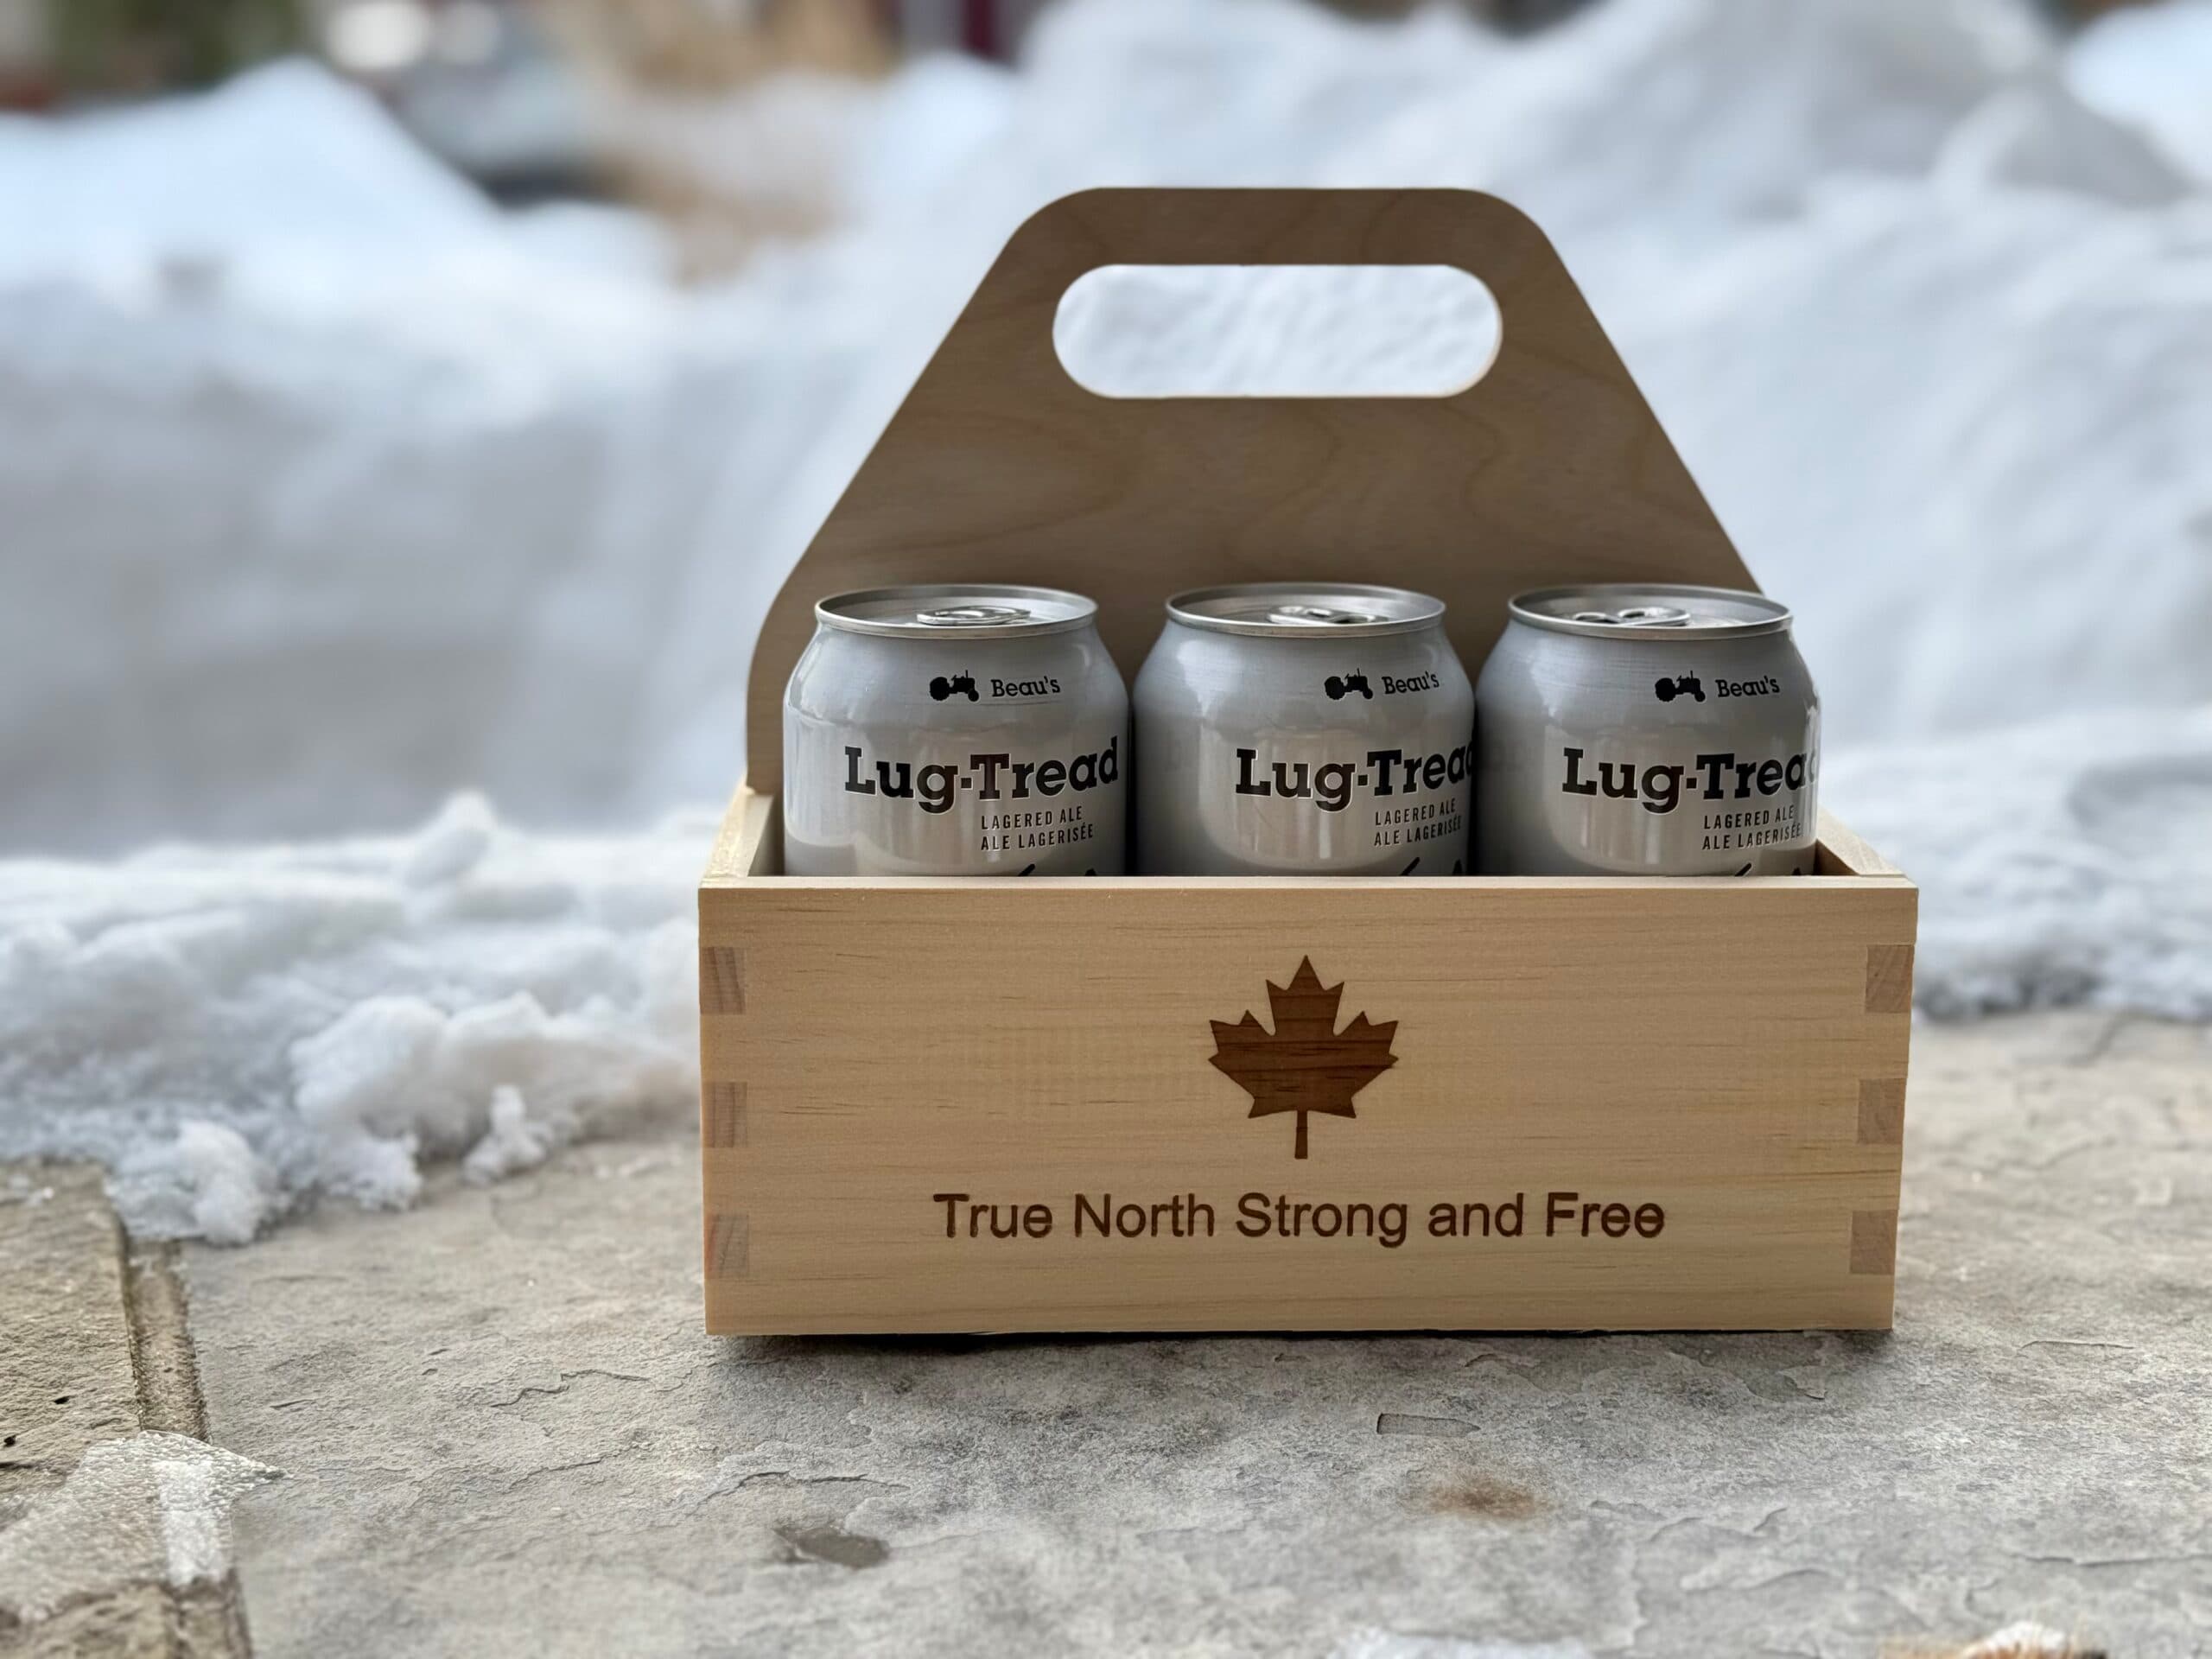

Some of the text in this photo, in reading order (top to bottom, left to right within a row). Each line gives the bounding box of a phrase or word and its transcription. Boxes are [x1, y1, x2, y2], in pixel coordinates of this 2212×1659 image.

[991, 676, 1061, 697] Beau's
[1382, 671, 1440, 695] Beau's
[1715, 676, 1780, 697] Beau's
[844, 736, 1119, 813] Lug-Tread
[981, 805, 1083, 830] LAGERED ALE
[1375, 798, 1456, 826] LAGERED ALE
[1704, 804, 1795, 830] LAGERED ALE
[981, 822, 1094, 851] ALE LAGERISÉE
[1374, 830, 1400, 847] ALE
[1702, 835, 1731, 850] ALE
[934, 1192, 1665, 1249] True North Strong and Free
